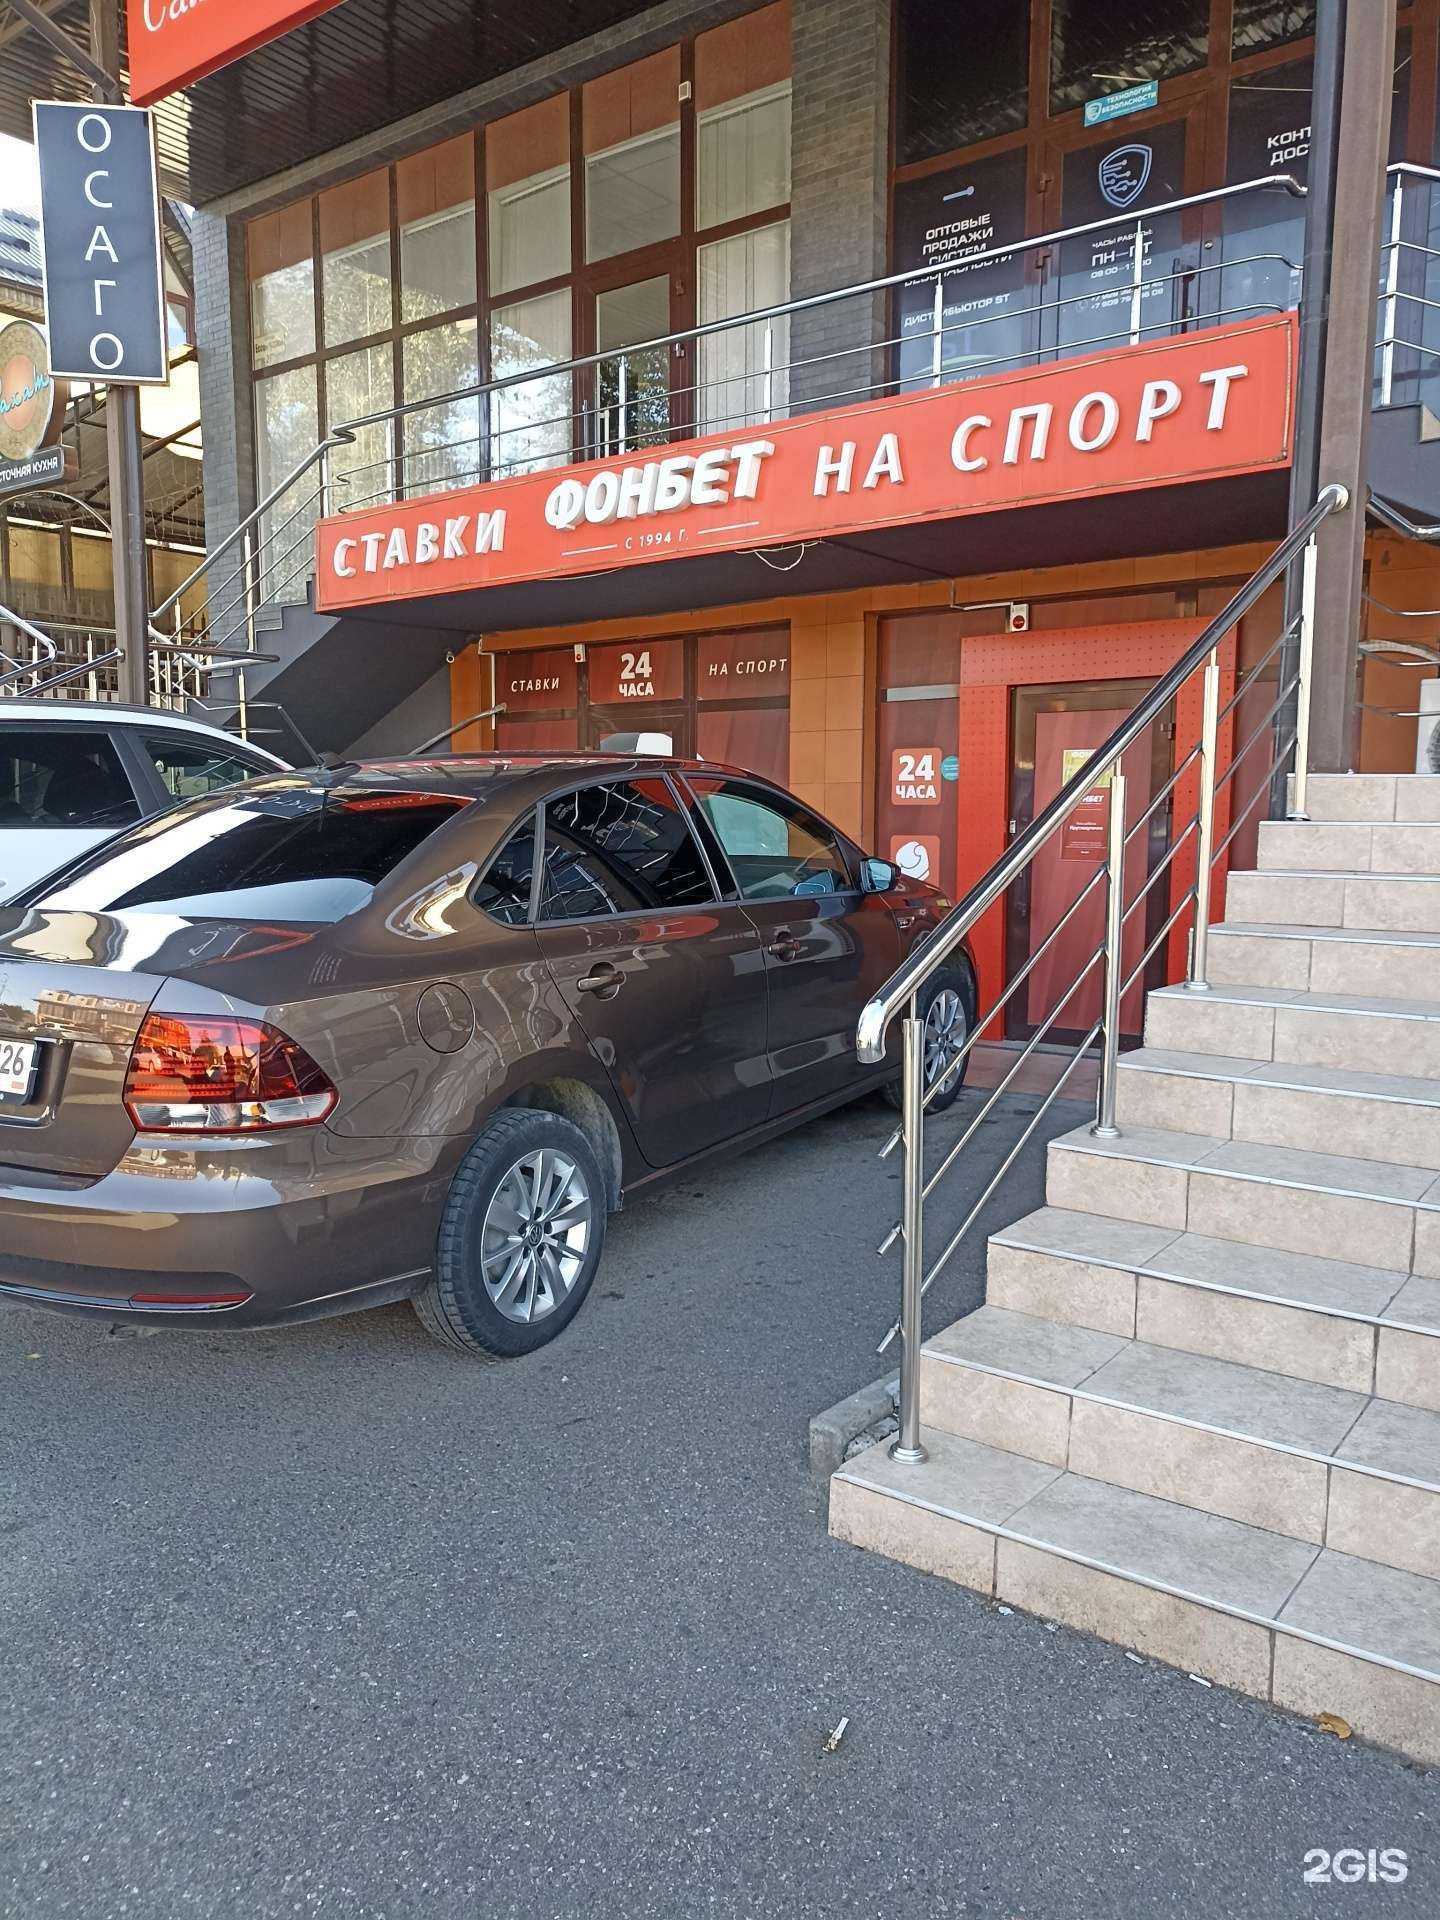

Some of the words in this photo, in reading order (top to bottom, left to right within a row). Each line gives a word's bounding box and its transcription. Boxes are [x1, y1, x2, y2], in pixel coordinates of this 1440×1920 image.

[1270, 143, 1311, 166] ДОС
[925, 213, 991, 240] ОПТОВЫЕ
[77, 113, 124, 370] ОСАГО
[922, 227, 994, 256] ПРОДАЖИ
[903, 297, 993, 328] ДИСТИБЬЮТОР
[32, 456, 58, 474] КУХНЯ
[332, 509, 507, 578] СТАВКИ
[544, 440, 776, 531] ФОНБЕТ
[812, 433, 904, 497] НА
[950, 365, 1249, 473] СПОРТ
[625, 536, 633, 550] С
[639, 531, 672, 548] 1994
[620, 651, 653, 680] 24
[708, 662, 729, 677] НА
[735, 658, 788, 675] СПОРТ
[510, 677, 560, 693] СТАВКИ
[618, 681, 655, 698] ЧАСА
[898, 754, 935, 782] 24
[895, 784, 937, 799] ЧАСА
[0, 1044, 24, 1075] 26
